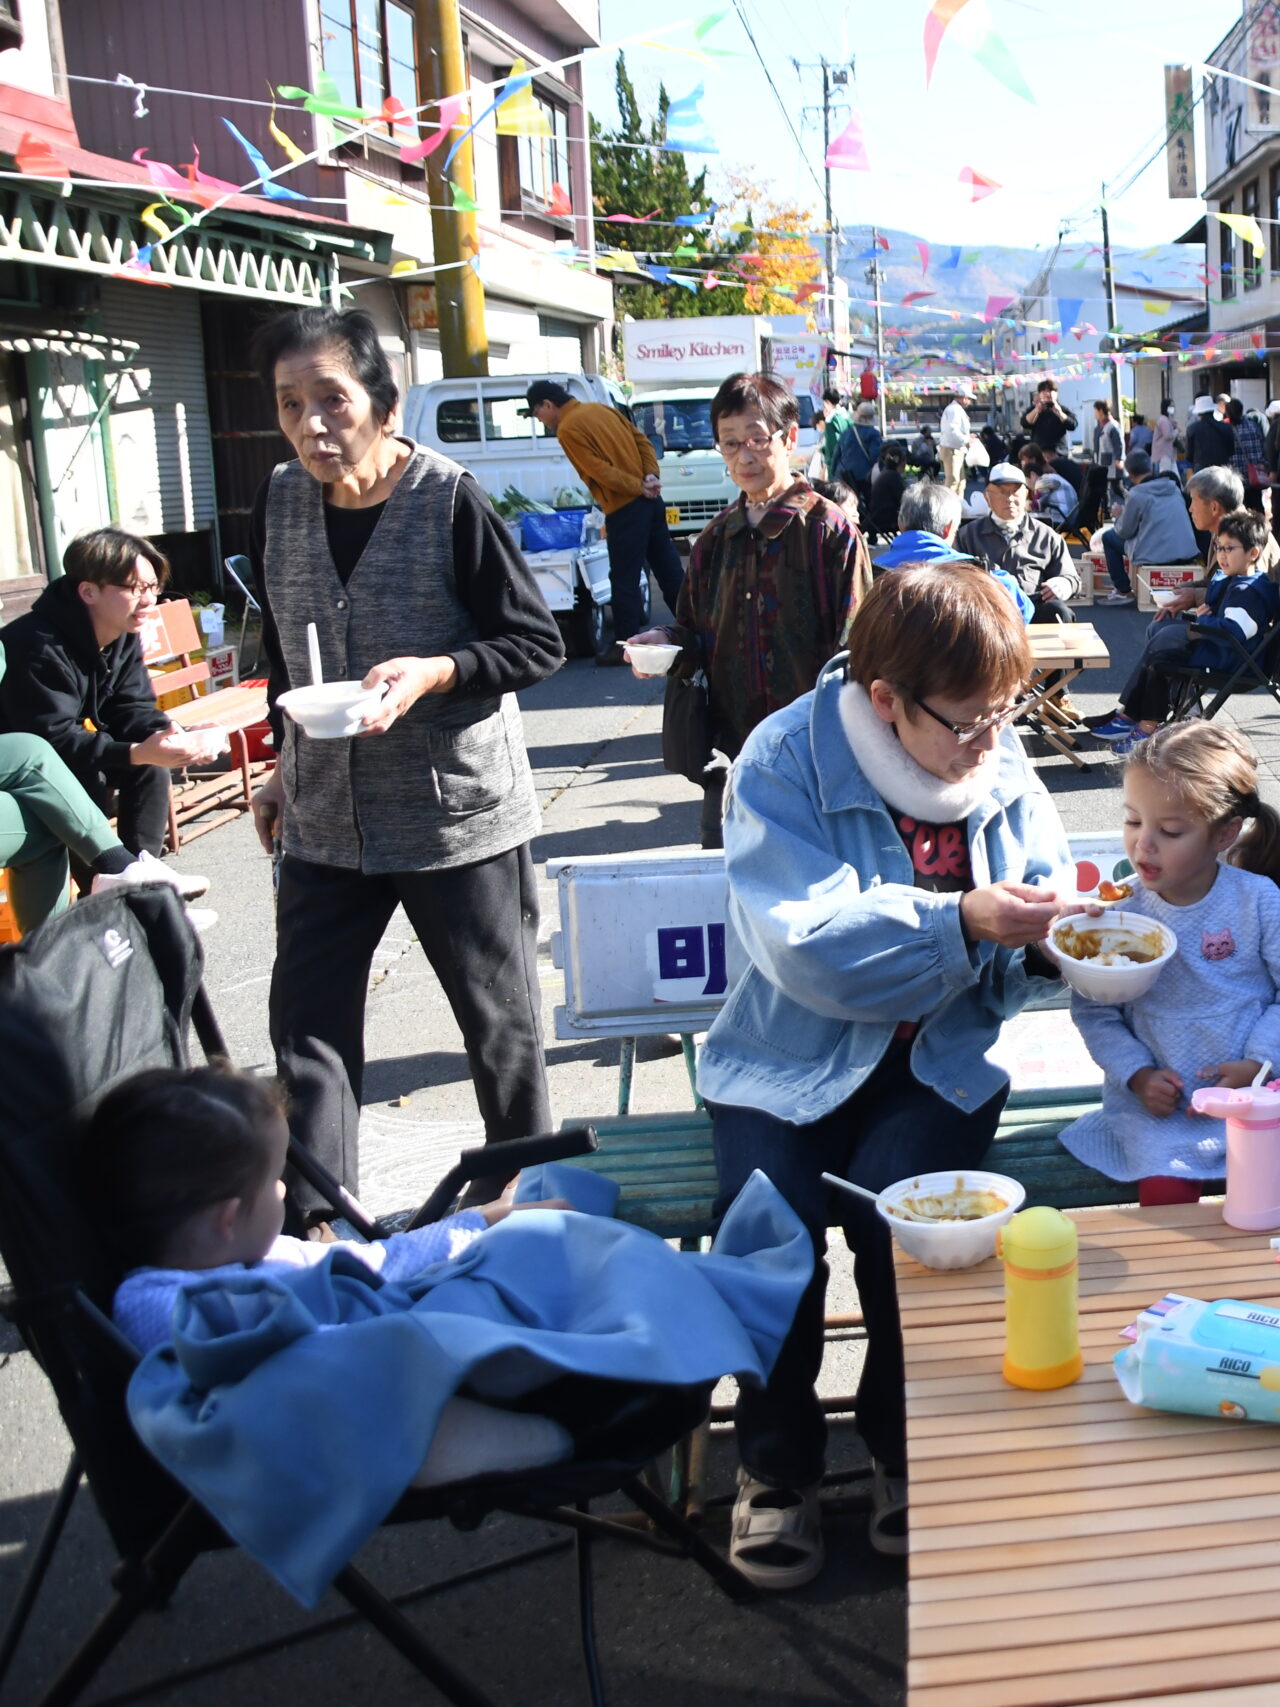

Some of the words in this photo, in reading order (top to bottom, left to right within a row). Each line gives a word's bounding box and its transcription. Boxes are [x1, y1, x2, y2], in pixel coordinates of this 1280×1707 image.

[637, 344, 685, 361] Smiley
[689, 342, 744, 357] Kitchen
[1246, 1311, 1280, 1325] RICO
[1219, 1356, 1252, 1373] RICO
